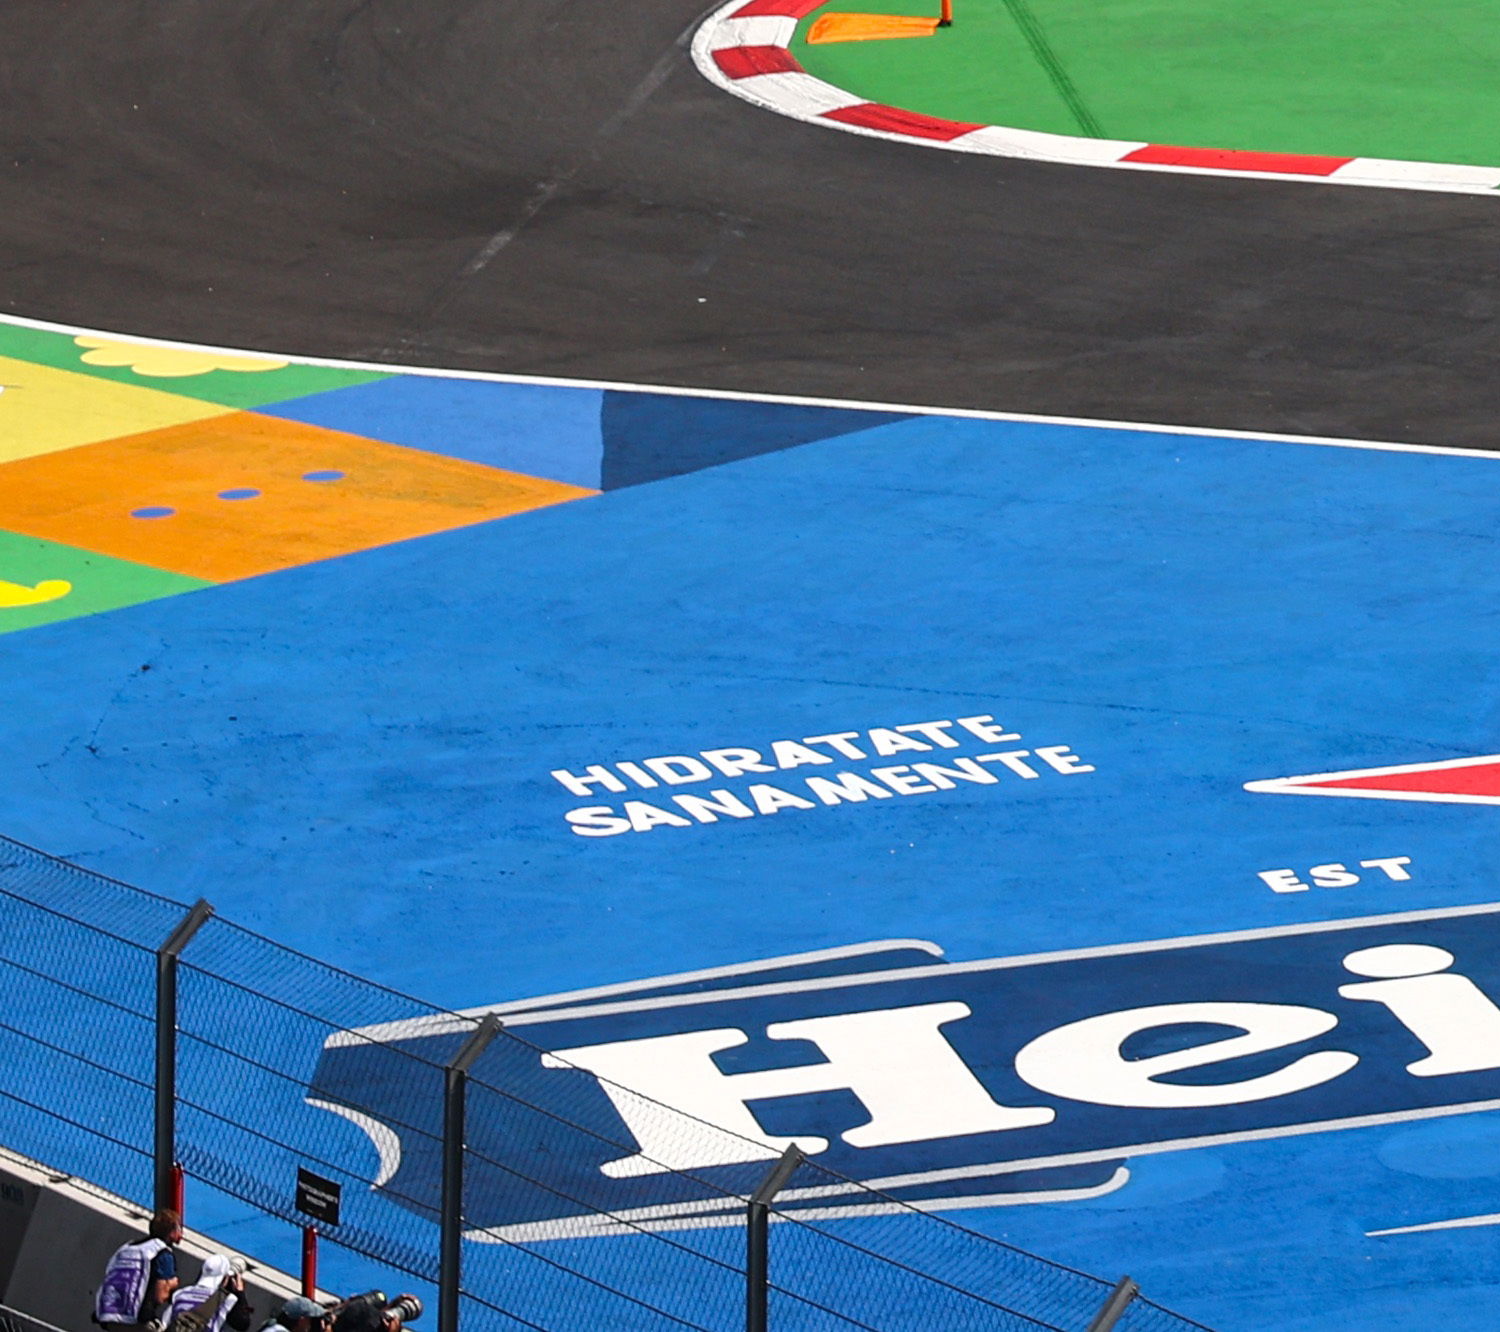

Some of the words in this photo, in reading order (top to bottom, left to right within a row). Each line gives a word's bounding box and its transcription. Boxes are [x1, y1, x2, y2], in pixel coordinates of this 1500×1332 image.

[549, 714, 1022, 798] HIDRATATE
[562, 744, 1097, 838] SANAMENTE
[1258, 857, 1410, 893] EST
